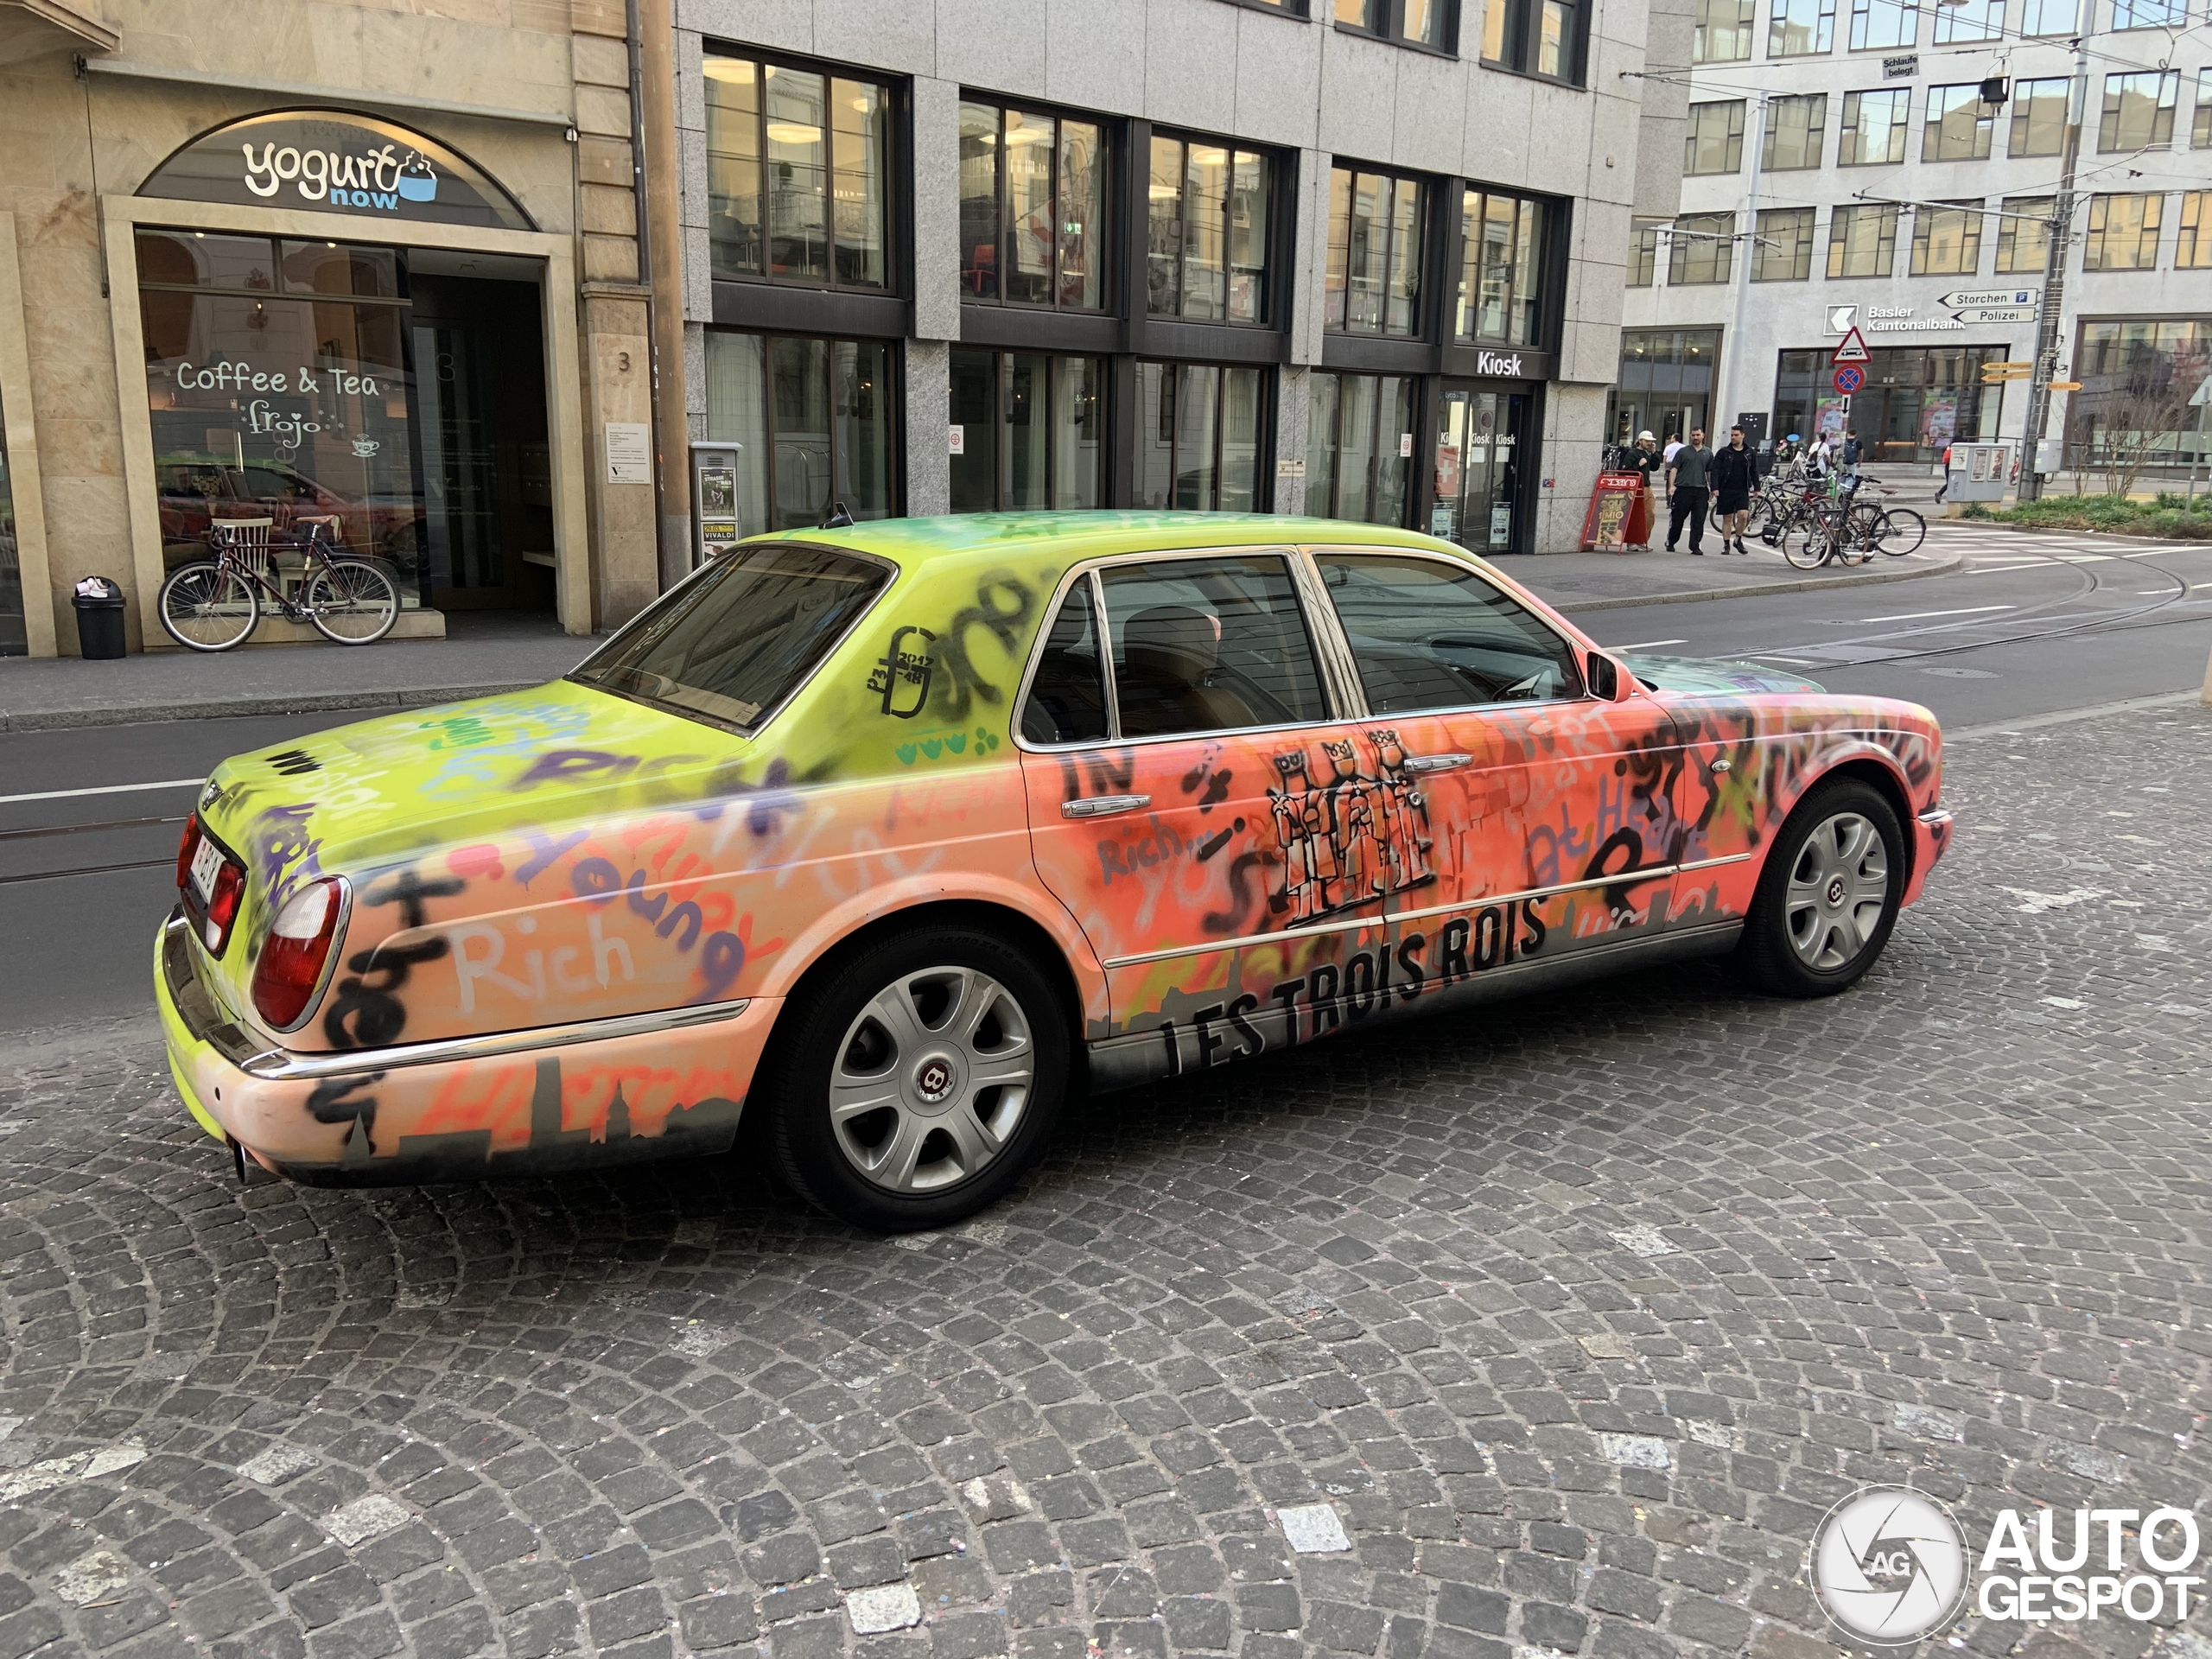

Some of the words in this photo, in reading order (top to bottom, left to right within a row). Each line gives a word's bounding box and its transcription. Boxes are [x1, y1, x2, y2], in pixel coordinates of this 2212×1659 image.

[1884, 55, 1917, 67] Schlaufe
[1888, 67, 1913, 77] belegt
[242, 141, 401, 200] yogurt
[1956, 294, 2007, 304] Storchen
[1868, 307, 1914, 319] Basler
[1980, 310, 2019, 321] Polizei
[436, 353, 455, 382] 3
[619, 352, 630, 372] 3
[1477, 351, 1522, 377] Kiosk
[177, 360, 288, 391] Coffee
[298, 366, 320, 394] &
[327, 368, 379, 397] Tea
[249, 399, 321, 448] frojo
[1471, 432, 1491, 444] Kiosk
[1496, 433, 1516, 445] Kiosk
[448, 912, 636, 1014] Rich
[1272, 931, 1428, 1046] TROIS
[1441, 896, 1548, 988] ROIS
